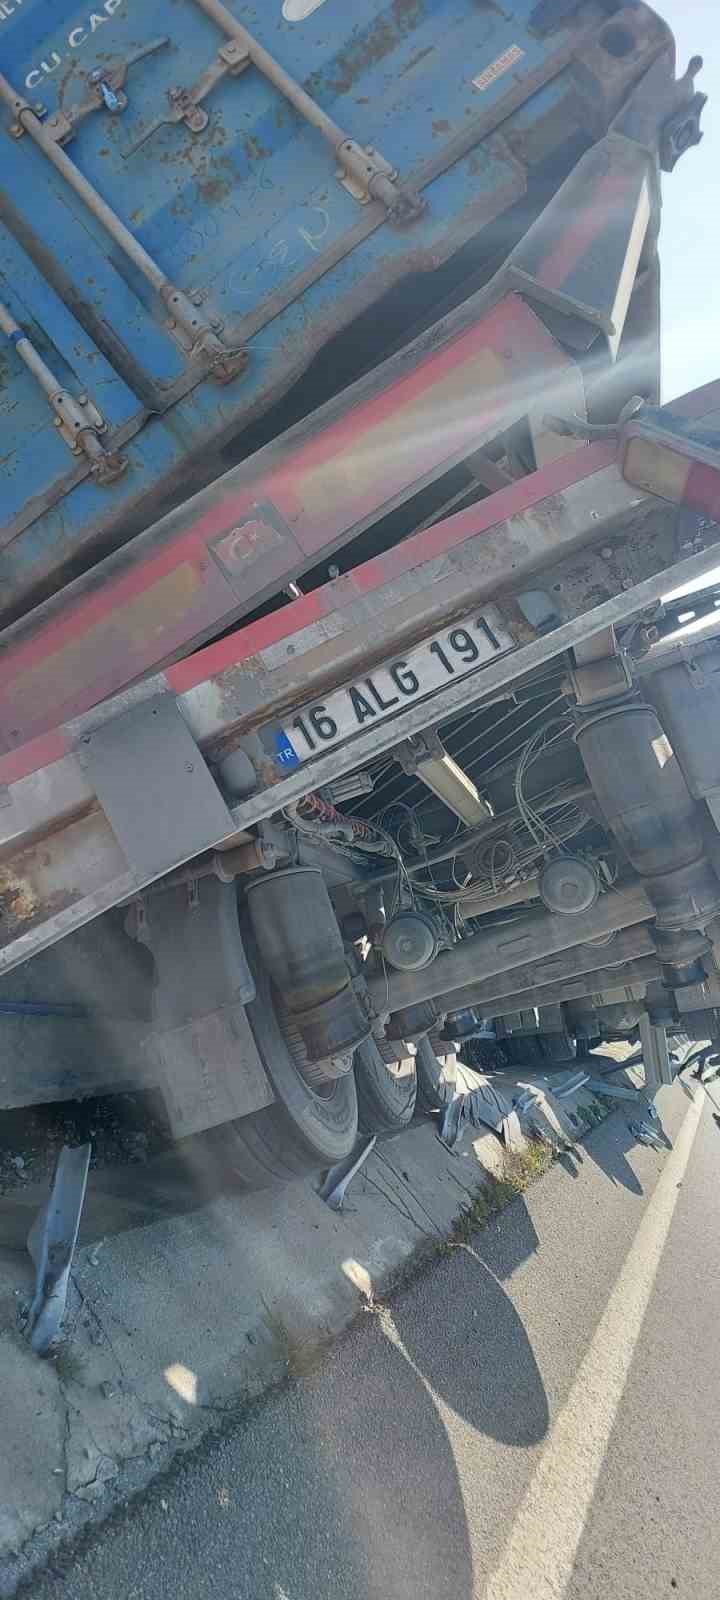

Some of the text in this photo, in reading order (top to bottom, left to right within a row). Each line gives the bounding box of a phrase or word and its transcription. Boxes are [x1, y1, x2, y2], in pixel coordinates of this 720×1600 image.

[292, 616, 501, 750] 16 ALG 191
[278, 746, 295, 763] TR
